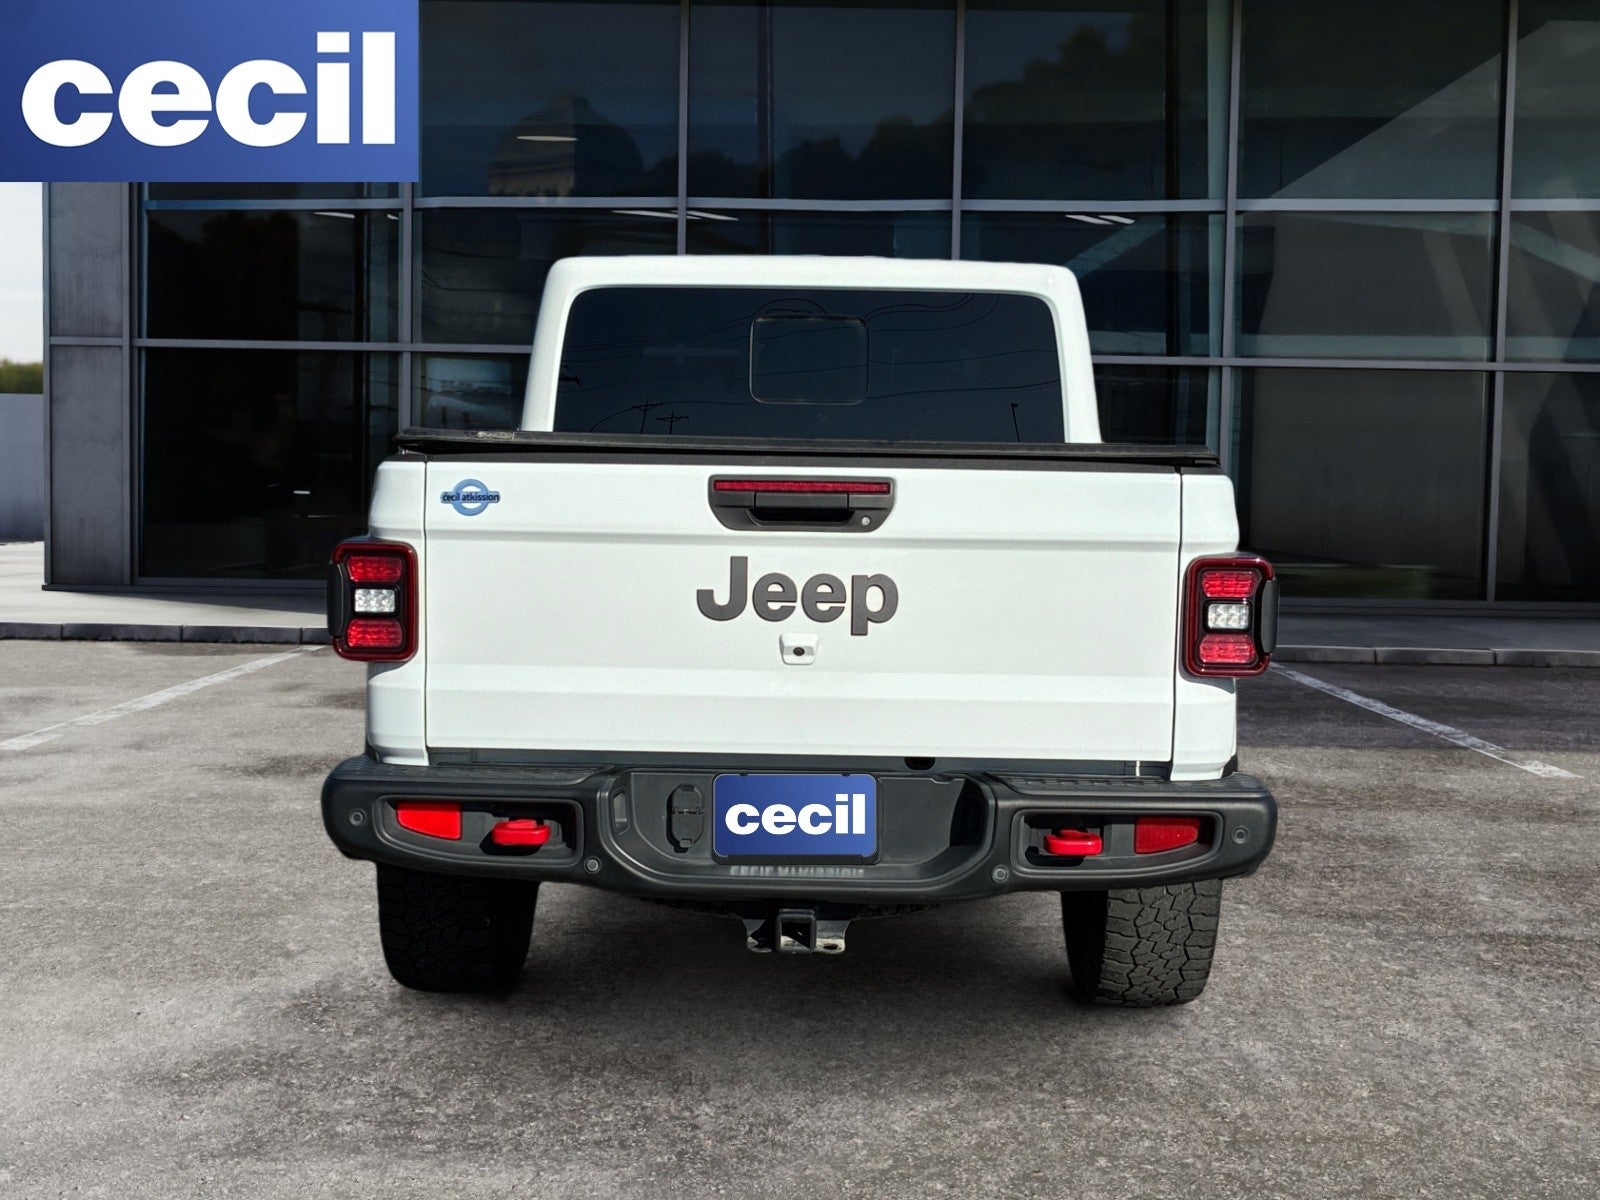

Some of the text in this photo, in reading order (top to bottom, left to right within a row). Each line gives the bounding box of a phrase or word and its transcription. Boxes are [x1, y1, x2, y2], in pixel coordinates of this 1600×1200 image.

[442, 492, 500, 502] cecil atkission
[696, 555, 899, 636] Jeep
[725, 793, 866, 835] cecil
